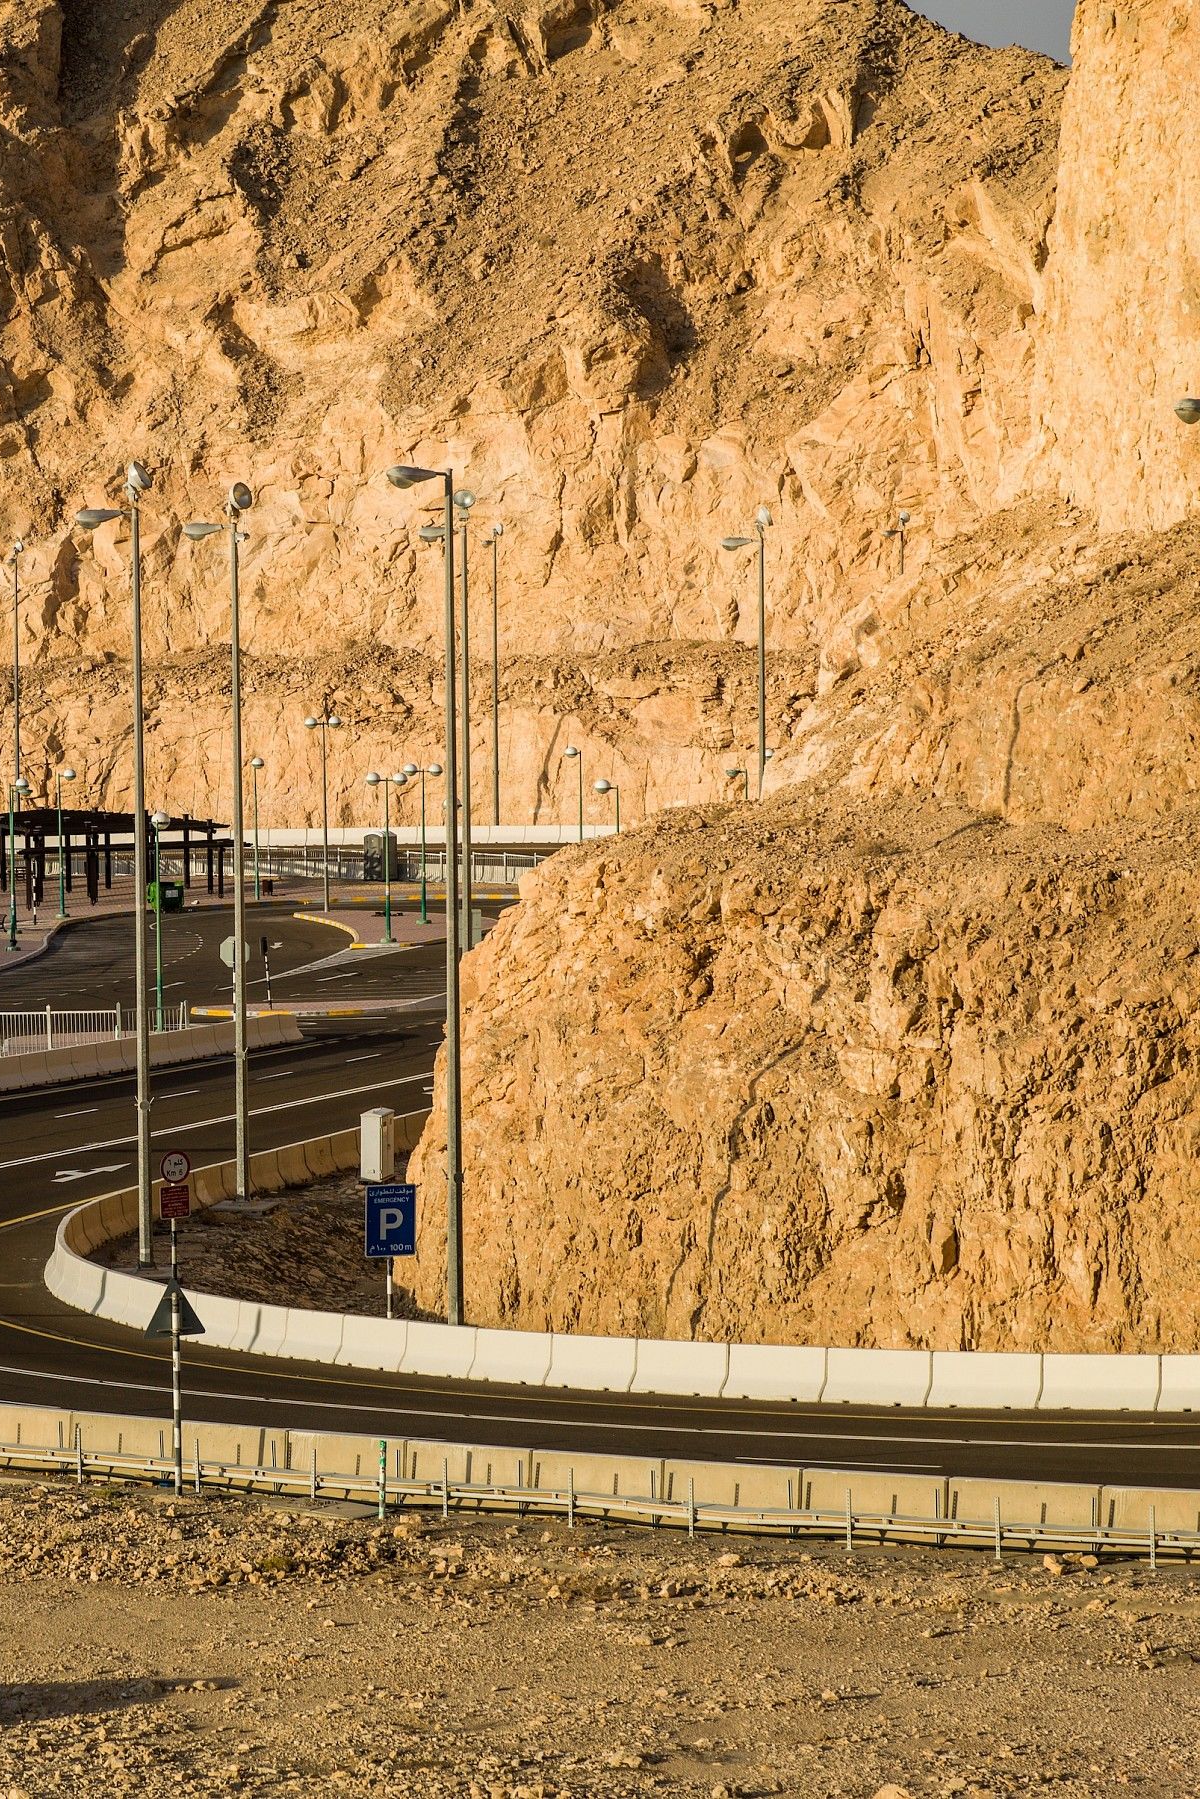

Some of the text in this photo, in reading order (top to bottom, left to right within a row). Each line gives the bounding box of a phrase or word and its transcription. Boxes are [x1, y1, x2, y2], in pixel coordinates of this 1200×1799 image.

[395, 1187, 413, 1195] موقف
[374, 1196, 410, 1204] EMERGENCY
[379, 1208, 404, 1241] P
[390, 1243, 404, 1251] 100
